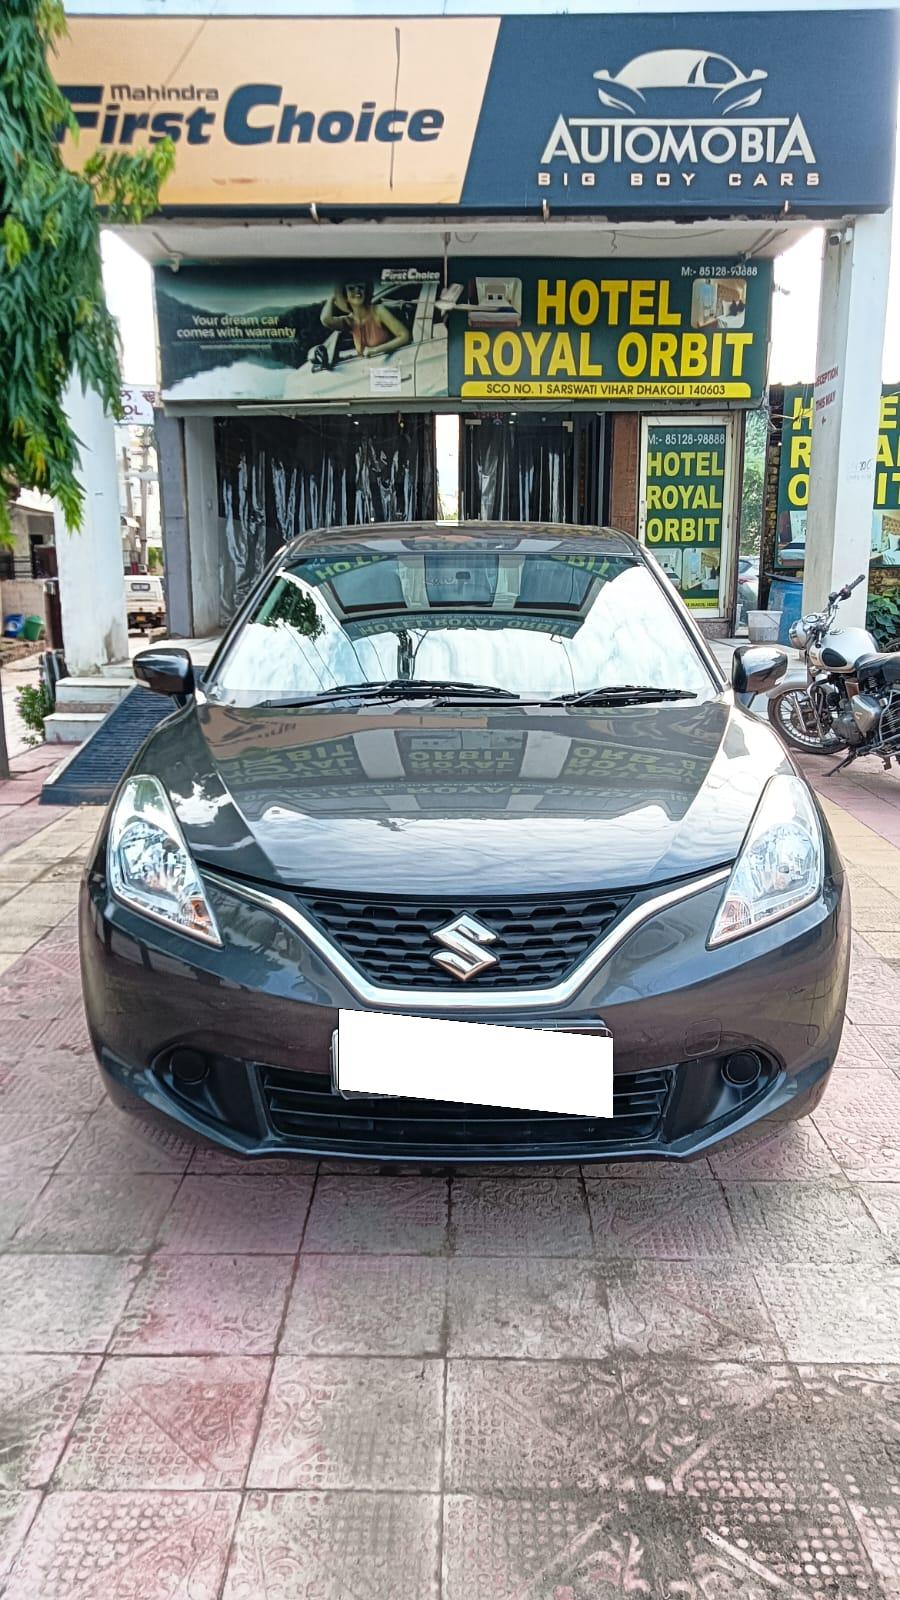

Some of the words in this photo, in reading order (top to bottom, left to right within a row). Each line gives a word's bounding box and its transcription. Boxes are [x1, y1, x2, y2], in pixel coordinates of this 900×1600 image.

[110, 84, 219, 101] Mahindra
[58, 85, 216, 145] First
[222, 83, 445, 145] Choice
[540, 113, 817, 165] AUTOMOBIA
[537, 172, 595, 187] BIG
[630, 172, 696, 187] BOY
[728, 172, 820, 187] CARS
[537, 279, 682, 326] HOTEL
[177, 328, 215, 338] comes
[217, 327, 243, 337] with
[245, 327, 296, 339] warranty
[192, 315, 218, 326] Your
[220, 315, 258, 326] dream
[261, 316, 279, 326] car
[464, 331, 602, 377] ROYAL
[617, 331, 753, 378] ORBIT
[486, 383, 511, 394] SCO
[513, 384, 534, 394] NO.
[546, 384, 597, 395] SARSWATI
[600, 384, 634, 395] VIHAR
[636, 385, 685, 395] DHAKOLI
[689, 385, 725, 395] 140603
[665, 433, 725, 445] 85128-98888
[647, 451, 725, 477] HOTEL
[647, 485, 722, 510] ROYAL
[647, 517, 720, 542] ORBIT
